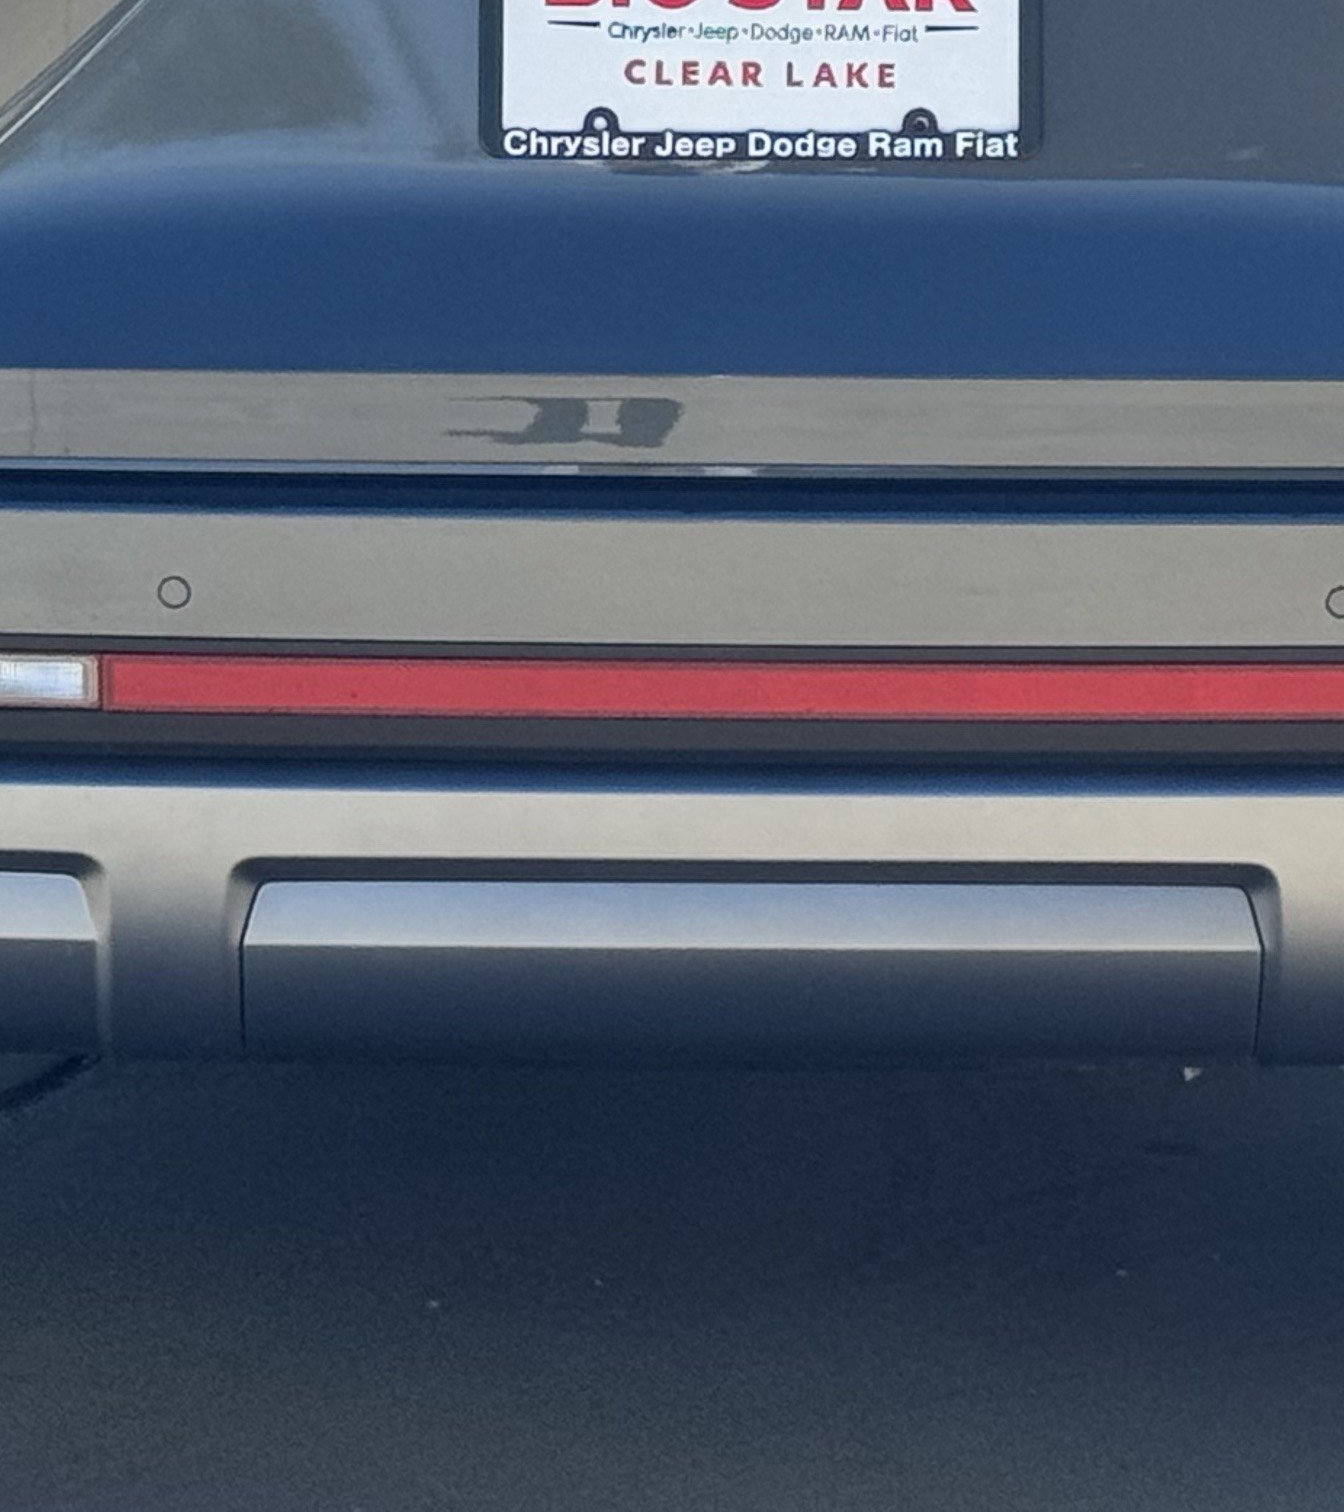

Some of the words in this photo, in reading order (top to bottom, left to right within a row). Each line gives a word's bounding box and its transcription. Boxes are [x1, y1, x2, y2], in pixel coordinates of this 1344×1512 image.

[623, 58, 763, 88] CLEAR
[786, 61, 896, 89] LAKE
[503, 129, 646, 159] Chrysler
[654, 130, 737, 158] Jeep
[747, 131, 858, 159] Dodge
[868, 131, 944, 159] Ram
[955, 131, 1019, 159] Fiat
